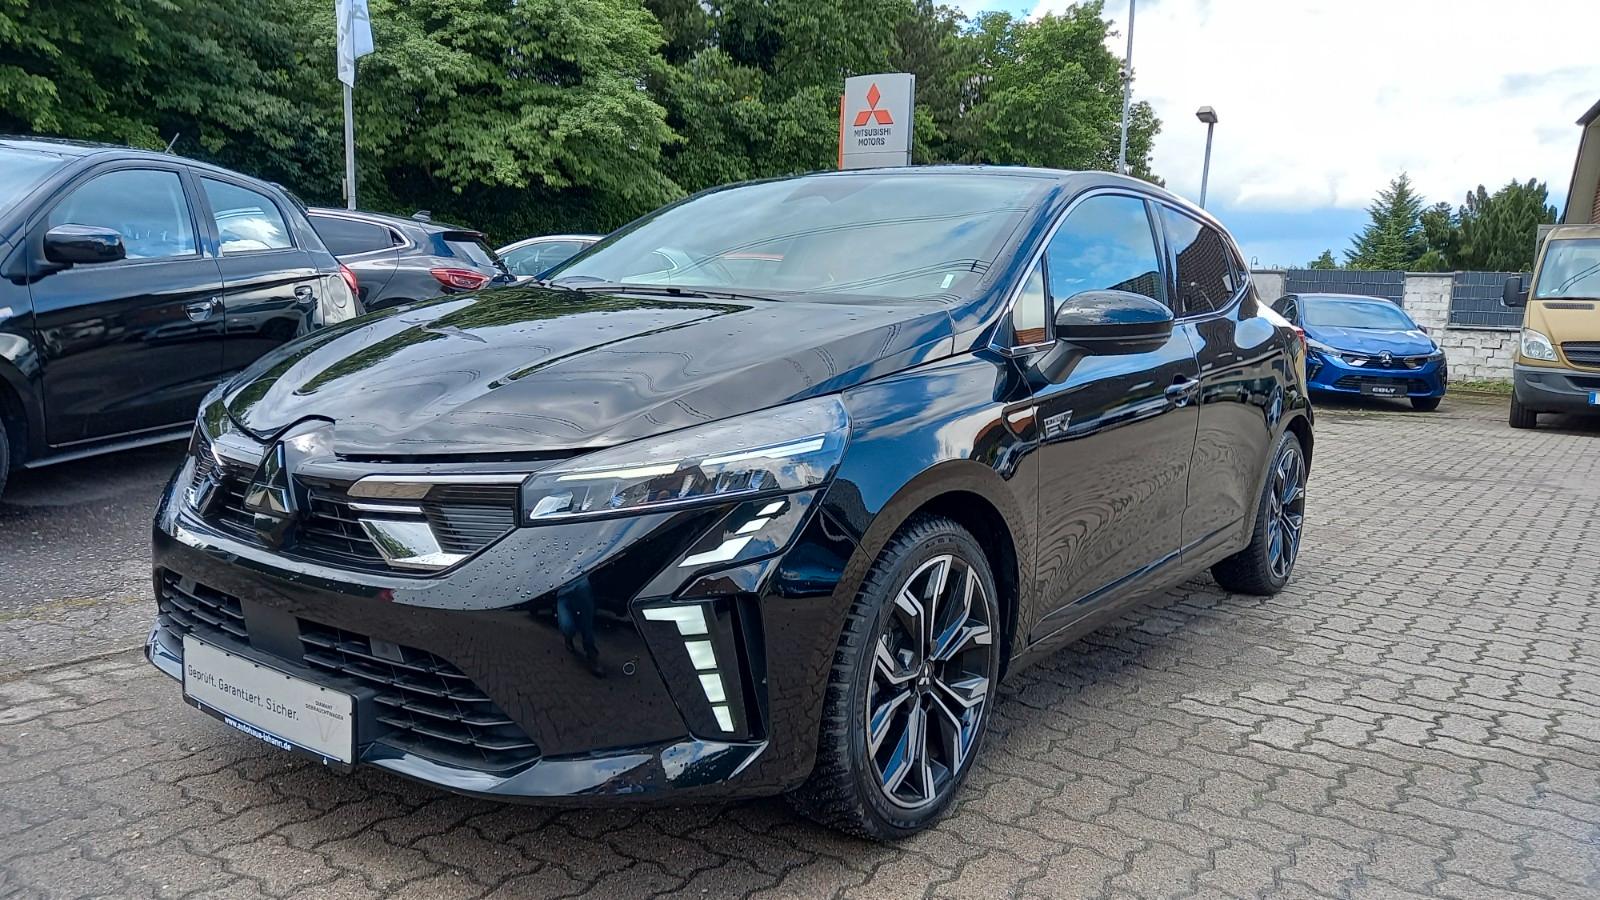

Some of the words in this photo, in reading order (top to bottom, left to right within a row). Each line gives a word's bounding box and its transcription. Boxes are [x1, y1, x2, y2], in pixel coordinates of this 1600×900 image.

[854, 128, 892, 137] MITSUBISHI
[858, 137, 886, 146] MOTORS
[188, 664, 217, 688] Geprüft.
[218, 678, 264, 707] Garantiert.
[266, 697, 299, 721] Sicher.
